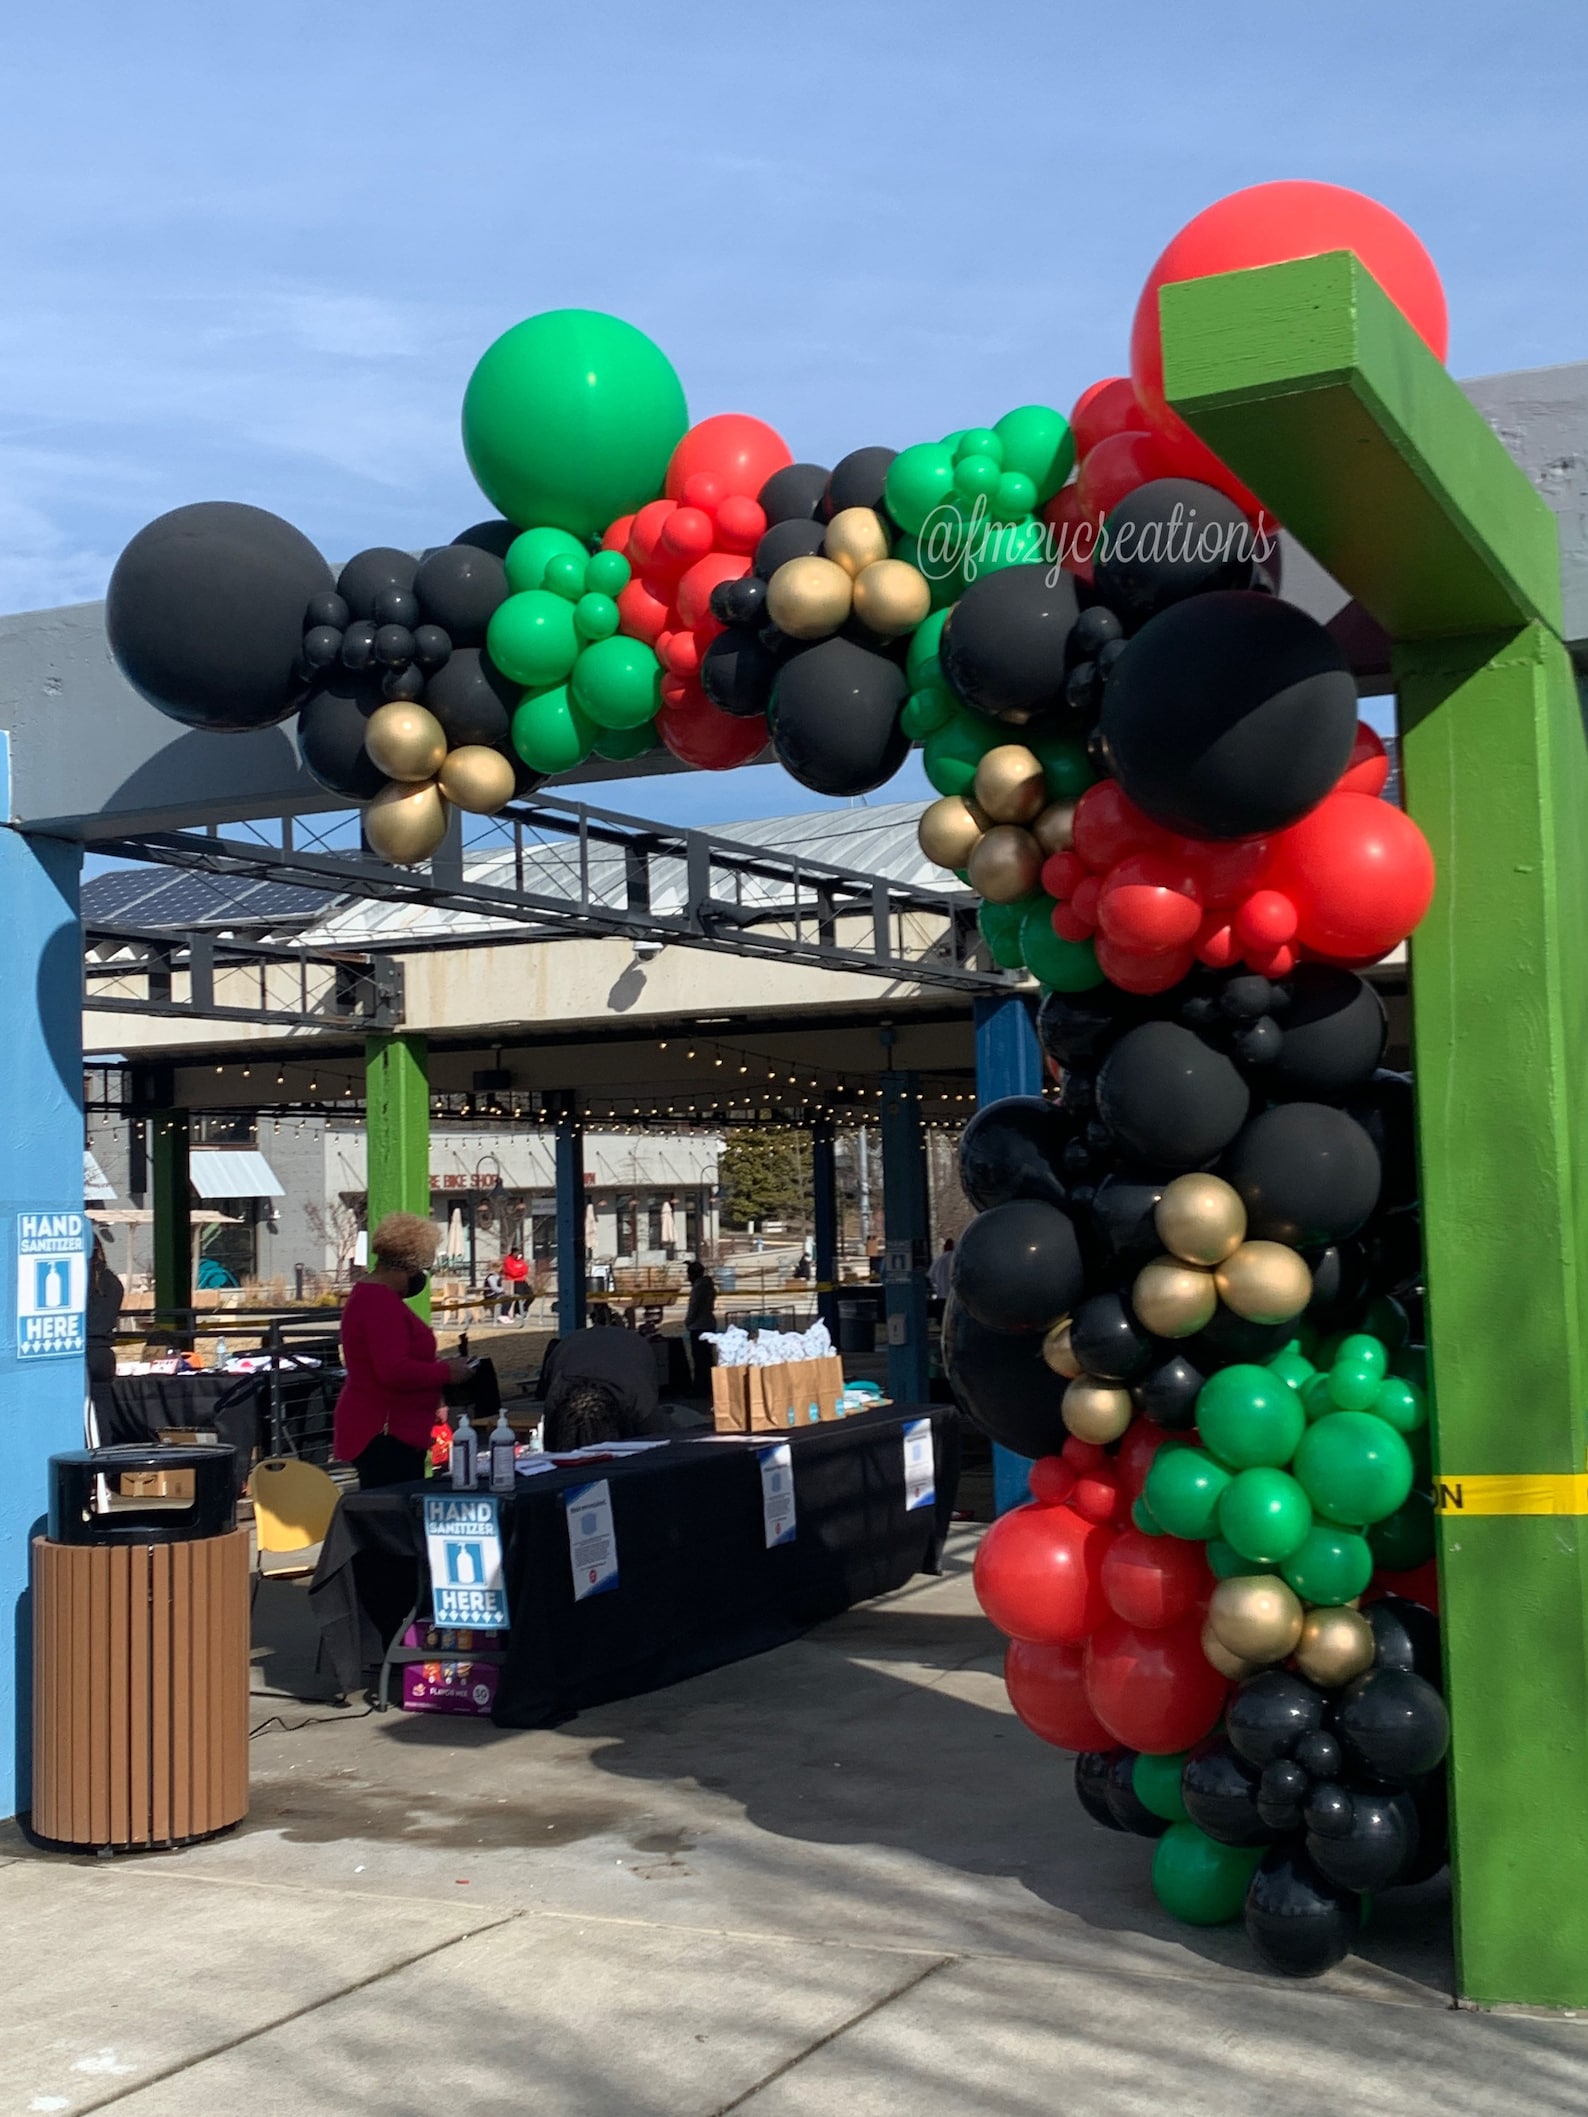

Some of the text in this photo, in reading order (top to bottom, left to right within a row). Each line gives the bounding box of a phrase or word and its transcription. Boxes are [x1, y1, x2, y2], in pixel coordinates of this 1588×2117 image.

[443, 1175, 466, 1188] BIKE
[22, 1215, 82, 1238] HAND
[20, 1237, 83, 1253] SANITIZER
[26, 1315, 79, 1340] HERE
[429, 1502, 491, 1522] HAND
[428, 1521, 496, 1536] SANITIZER
[441, 1590, 497, 1611] HERE
